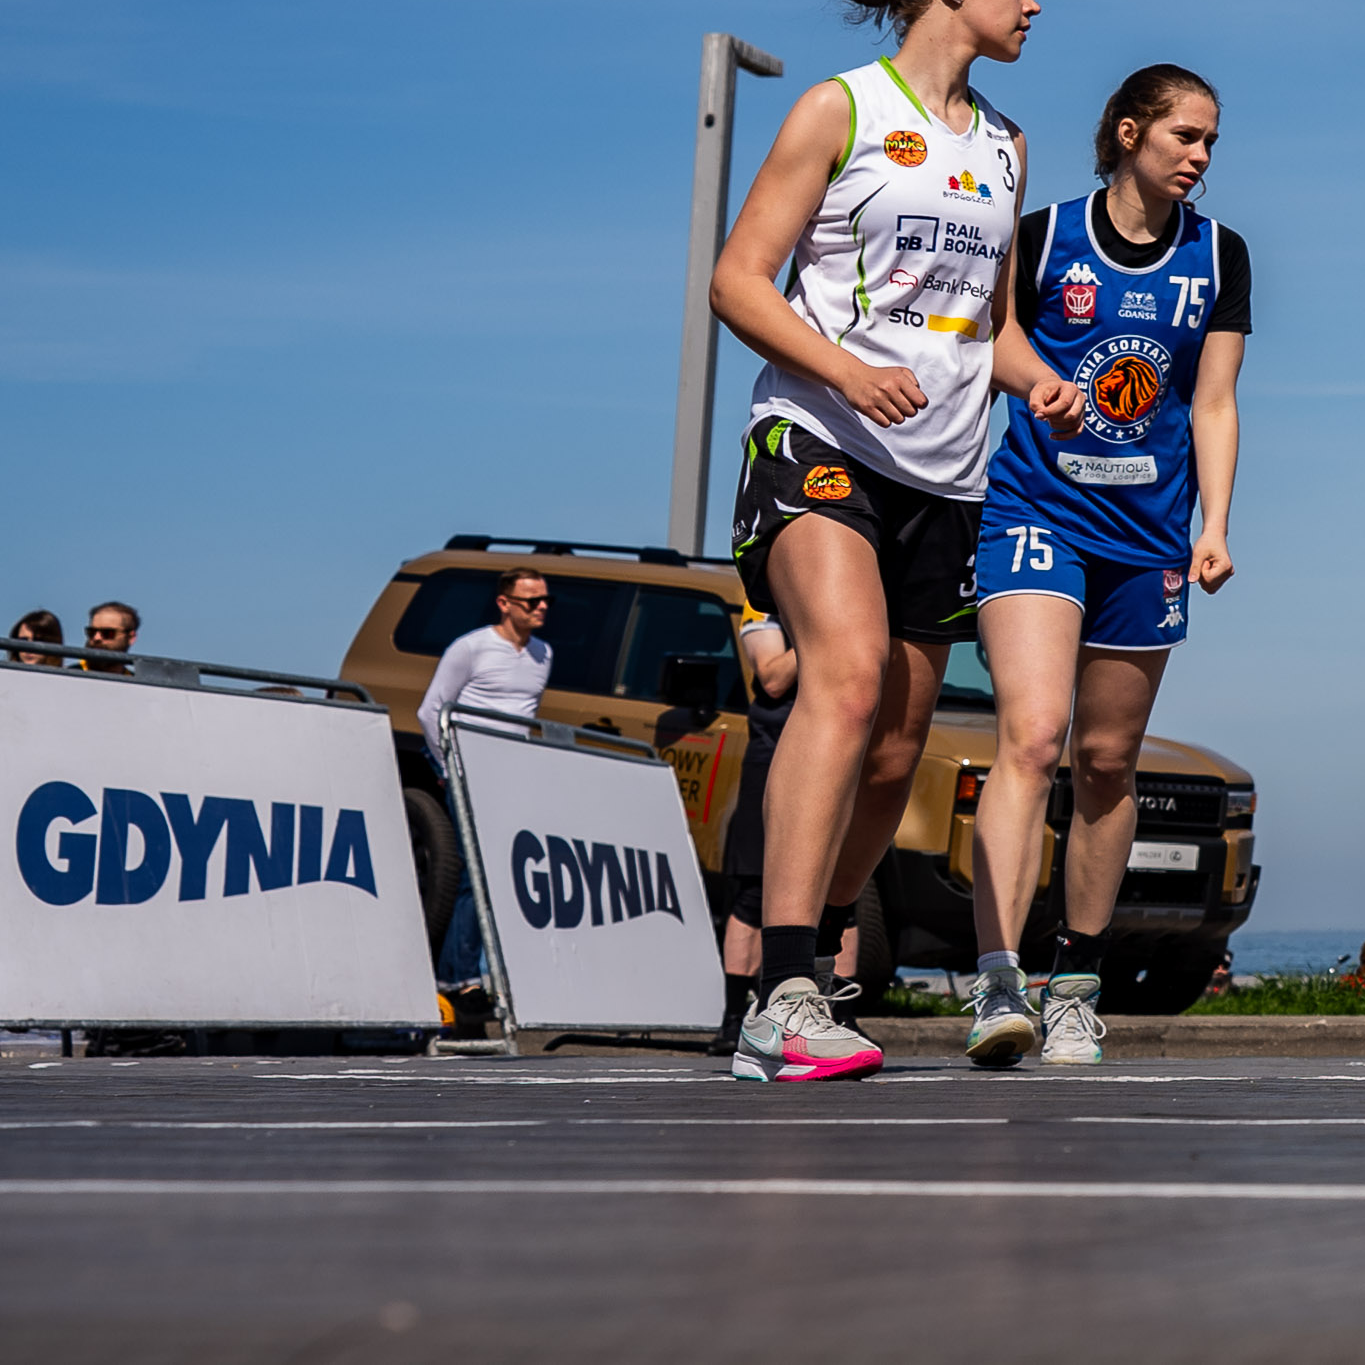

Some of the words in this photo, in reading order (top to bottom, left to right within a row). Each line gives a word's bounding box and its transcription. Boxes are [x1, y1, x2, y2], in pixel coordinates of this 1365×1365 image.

[884, 139, 927, 153] MUKS
[997, 149, 1015, 192] 3
[943, 191, 994, 206] BYDGOSZCZ
[946, 222, 982, 240] RAIL
[896, 236, 922, 250] RB
[924, 274, 957, 294] Bank
[1169, 276, 1209, 328] 75
[889, 305, 924, 327] sto
[1118, 309, 1157, 321] GDAŃSK
[1108, 340, 1170, 372] GORTATA
[1085, 462, 1150, 473] NAUTIOUS
[1006, 526, 1053, 573] 75
[658, 747, 709, 773] OWY
[16, 781, 378, 906] GDYNIA
[511, 829, 684, 930] GDYNIA
